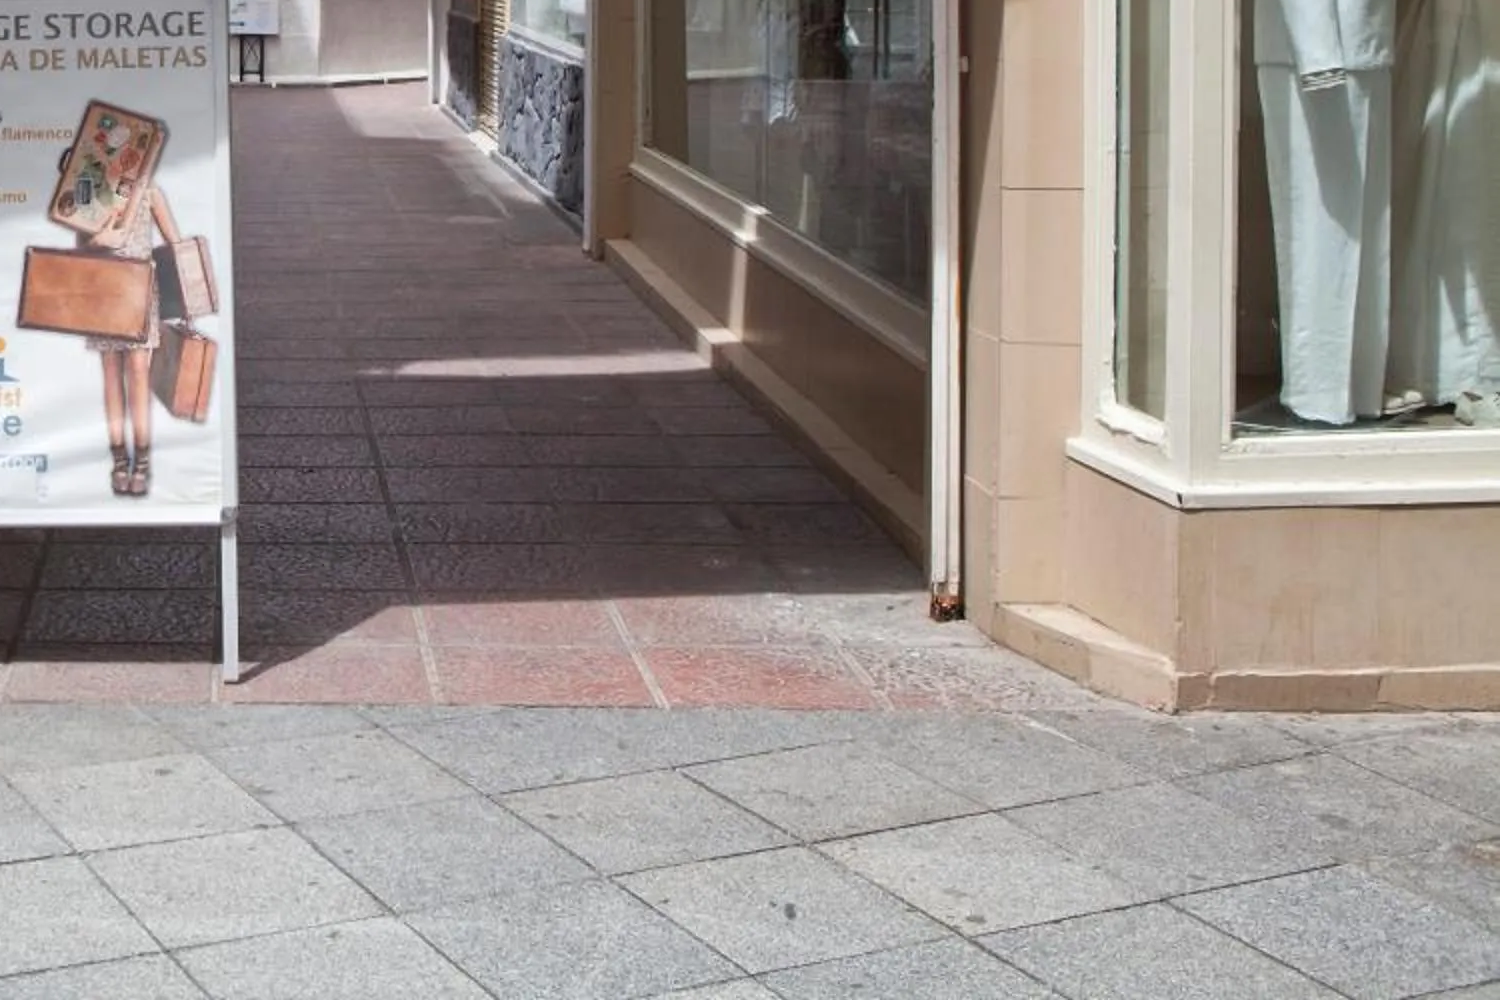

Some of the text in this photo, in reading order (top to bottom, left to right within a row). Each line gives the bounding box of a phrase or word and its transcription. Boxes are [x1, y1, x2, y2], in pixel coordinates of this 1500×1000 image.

[44, 11, 206, 40] STORAGE
[29, 48, 66, 71] DE
[77, 46, 206, 70] MALETAS
[1, 126, 73, 142] flamenco
